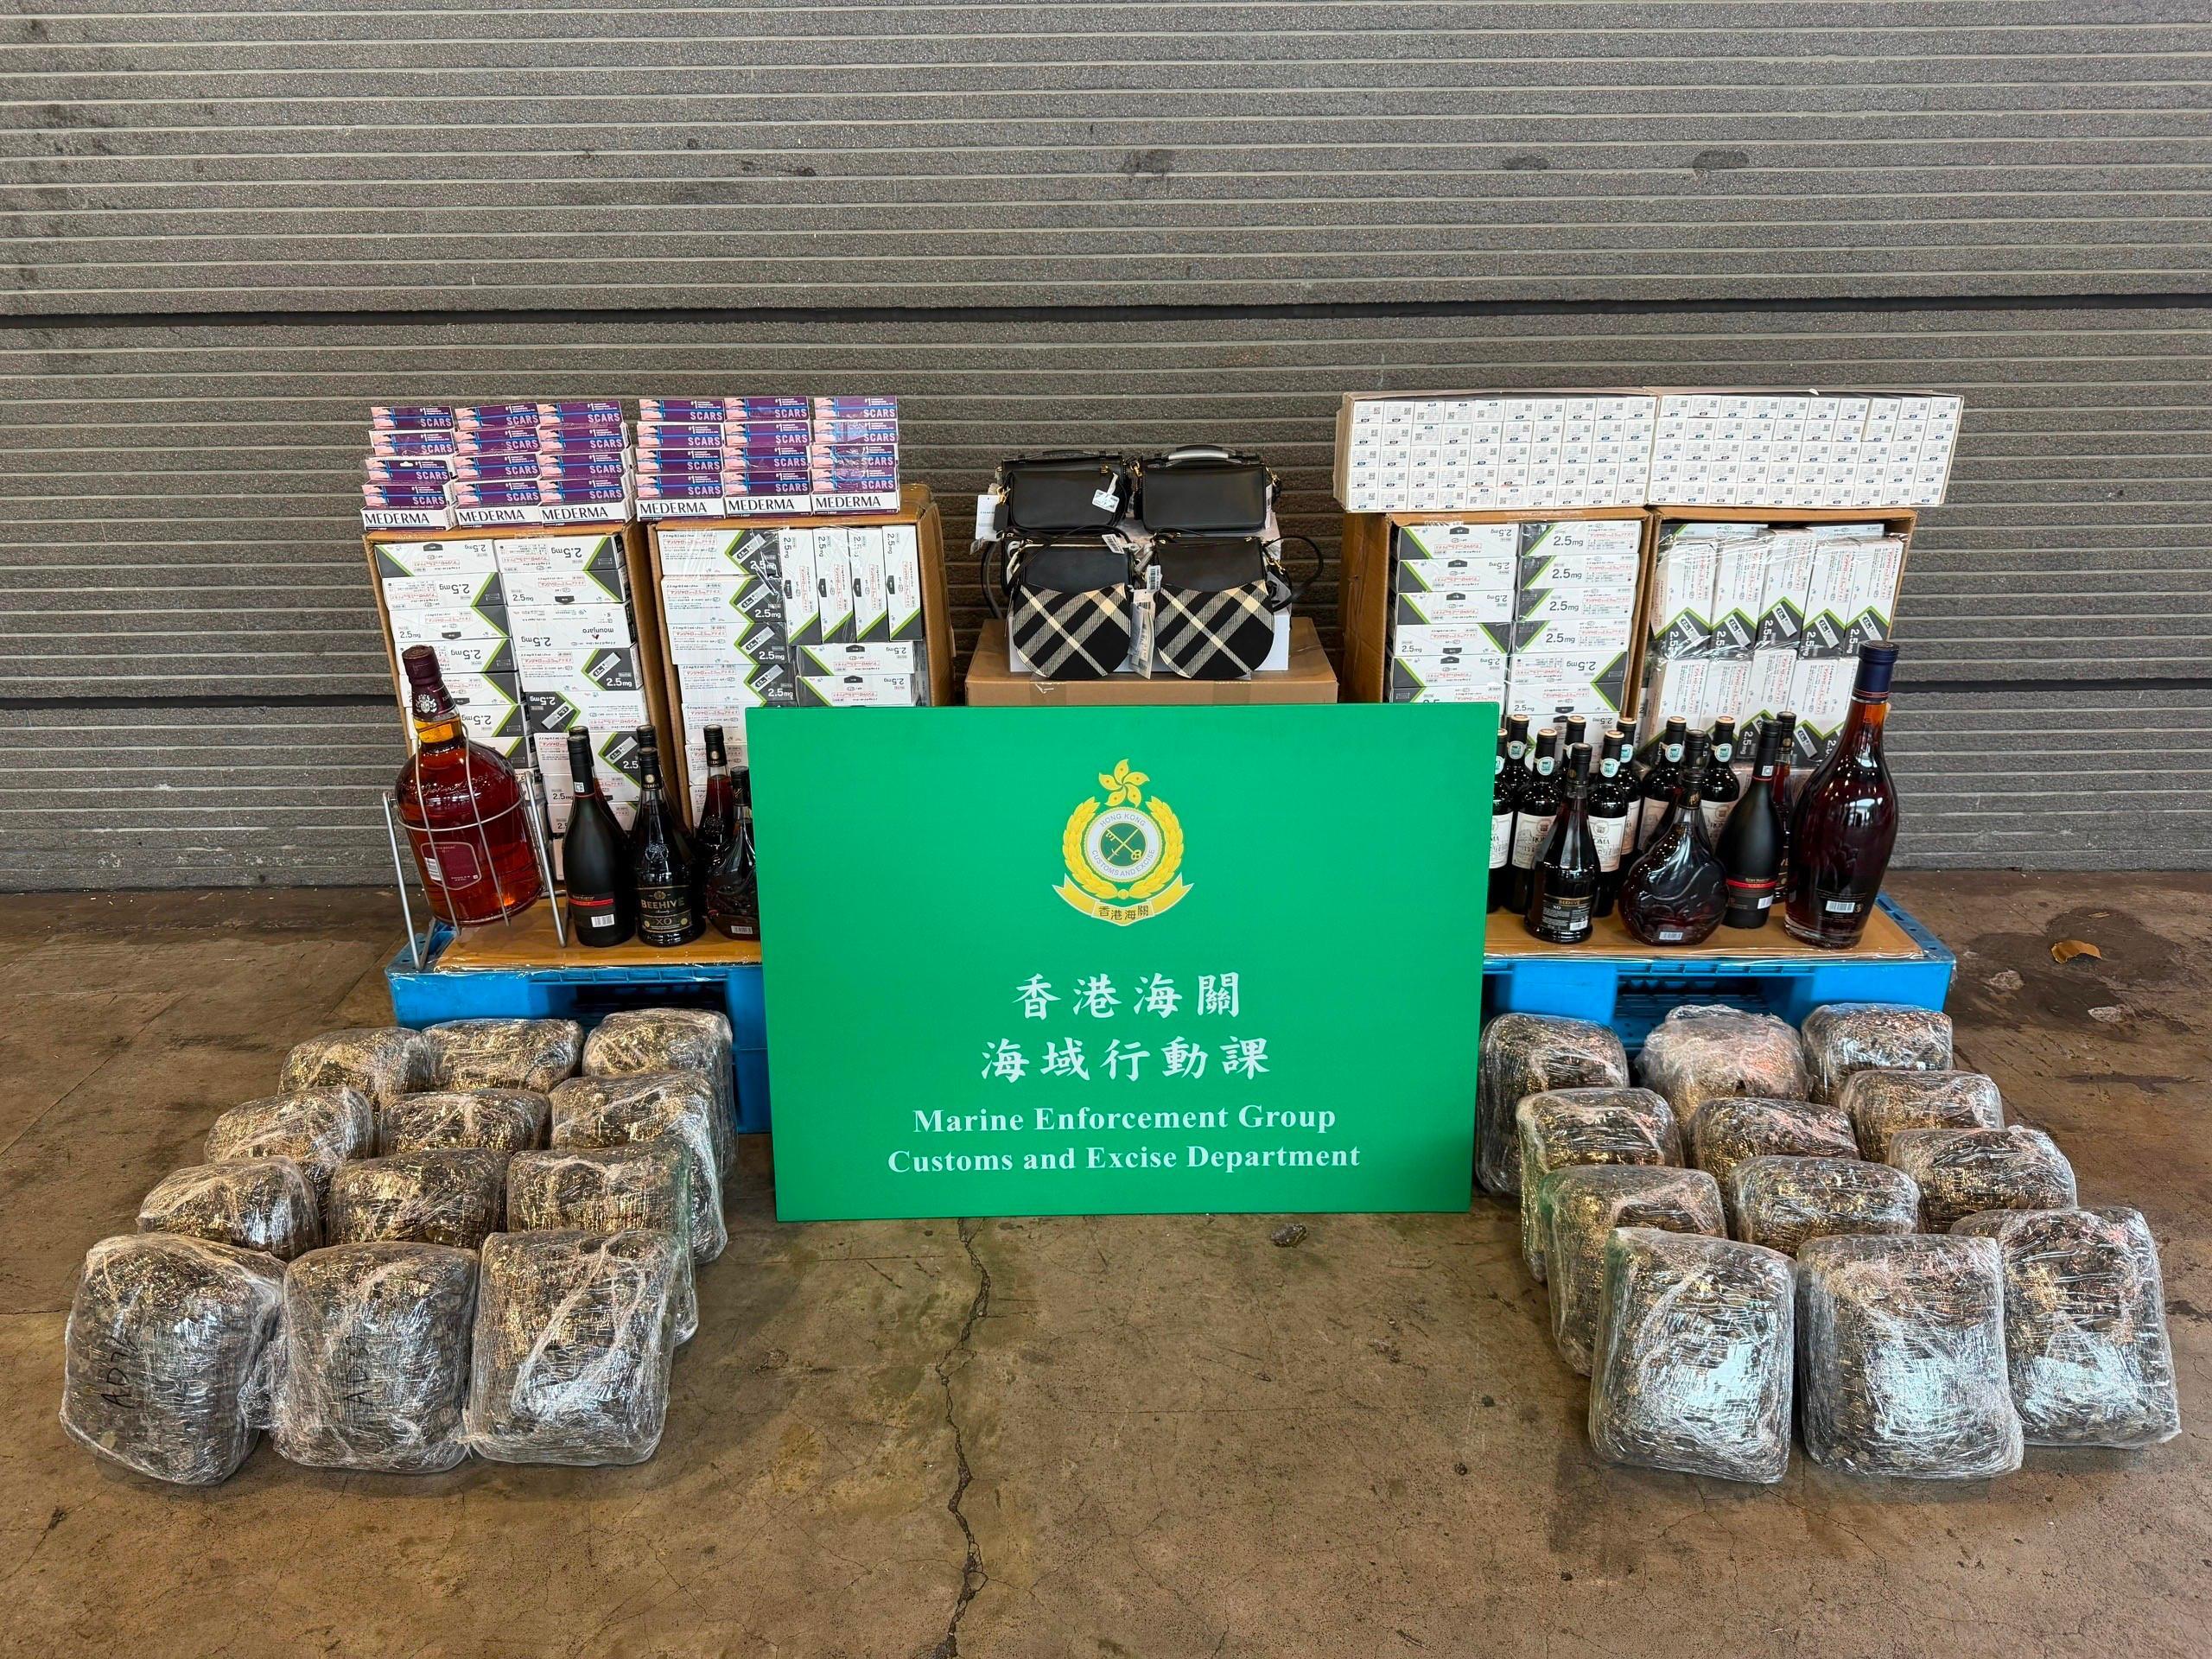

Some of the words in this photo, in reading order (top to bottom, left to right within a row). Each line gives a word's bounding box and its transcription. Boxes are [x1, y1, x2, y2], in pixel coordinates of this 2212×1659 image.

[588, 413, 620, 422] SCARS
[690, 411, 722, 420] SCARS
[775, 409, 807, 418] SCARS
[863, 409, 895, 418] SCARS
[420, 417, 452, 427] SCARS
[505, 416, 539, 425] SCARS
[688, 436, 721, 446] SCARS
[775, 435, 808, 444] SCARS
[863, 433, 896, 442] SCARS
[505, 441, 539, 449] SCARS
[589, 439, 623, 448] SCARS
[421, 444, 453, 454] SCARS
[687, 461, 720, 471] SCARS
[774, 458, 806, 467] SCARS
[861, 456, 893, 467] SCARS
[505, 466, 538, 475] SCARS
[589, 464, 622, 474] SCARS
[416, 471, 448, 480] SCARS
[775, 482, 808, 492] SCARS
[861, 480, 893, 489] SCARS
[589, 490, 622, 499] SCARS
[688, 486, 721, 495] SCARS
[412, 496, 445, 505] SCARS
[506, 492, 539, 501] SCARS
[816, 495, 880, 507] MEDERMA
[640, 502, 707, 514] MEDERMA
[729, 499, 794, 511] MEDERMA
[460, 510, 524, 522] MEDERMA
[543, 506, 608, 519] MEDERMA
[365, 513, 429, 525] MEDERMA
[1554, 536, 1583, 547] 2.5mg
[464, 543, 486, 552] 2.5mg
[551, 547, 582, 557] 2.5mg
[1552, 569, 1582, 579] 2.5mg
[439, 583, 470, 594] 2.5mg
[1549, 601, 1579, 612] 2.5mg
[521, 636, 551, 647] 2.5mg
[1546, 633, 1575, 644] 2.5mg
[450, 649, 480, 659] 2.5mg
[1567, 661, 1596, 671] 2.5mg
[606, 677, 632, 687] 2.5mg
[530, 696, 556, 705] 2.5mg
[461, 715, 491, 725] 2.5mg
[1740, 731, 1753, 754] 2.5mg
[1100, 813, 1122, 827] HONG
[1124, 813, 1146, 827] KONG
[1091, 849, 1119, 875] CUSTOMS
[1135, 849, 1155, 872] EXCISE
[641, 897, 684, 908] BEEHIVE
[1098, 906, 1149, 920] 香港海關
[1012, 972, 1241, 1020] 香港海關
[981, 1035, 1270, 1083] 海域行動課
[912, 1108, 1024, 1132] Marine
[1034, 1106, 1229, 1131] Enforcement
[1237, 1103, 1337, 1134] Group
[887, 1149, 1014, 1173] Customs
[1023, 1147, 1076, 1170] and
[1086, 1146, 1177, 1169] Excise
[1187, 1144, 1361, 1173] Department
